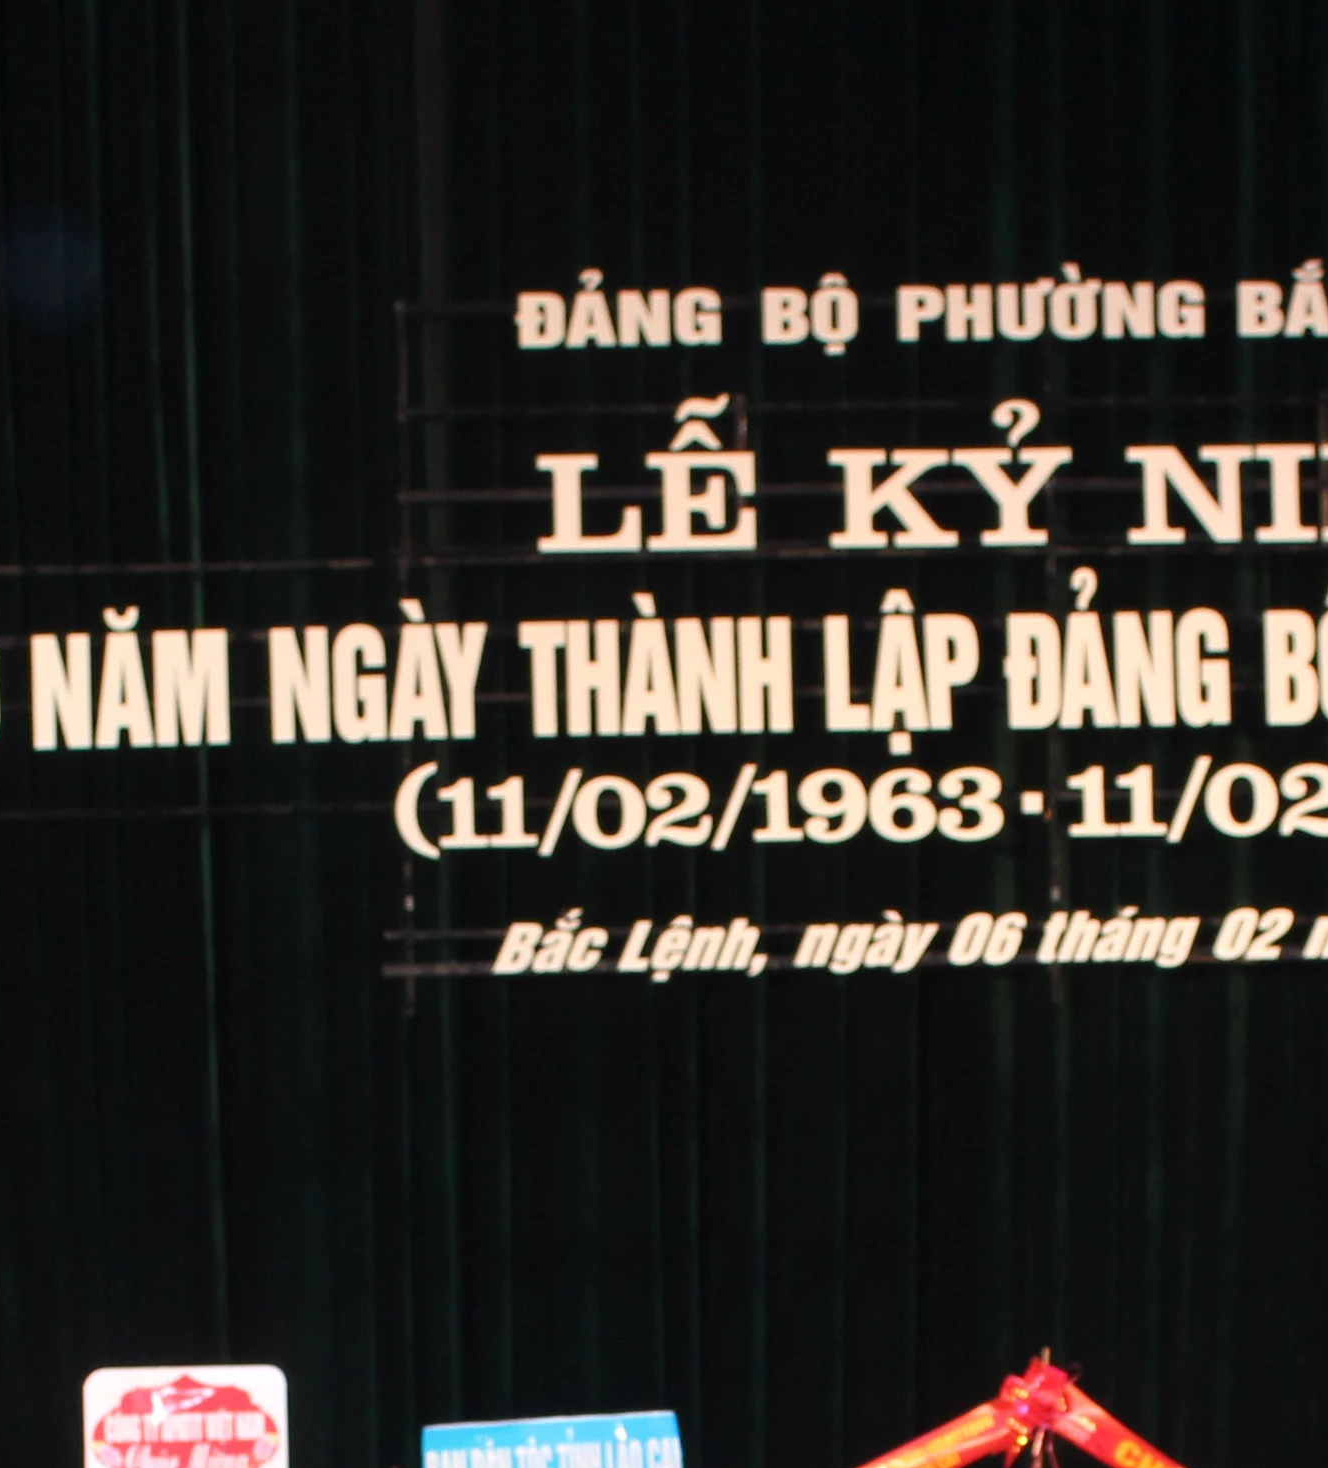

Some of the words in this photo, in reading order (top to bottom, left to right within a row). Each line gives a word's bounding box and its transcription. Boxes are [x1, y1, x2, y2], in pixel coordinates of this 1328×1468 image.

[515, 270, 722, 350] ĐẢNG
[762, 273, 858, 355] BỘ
[897, 263, 1205, 343] PHƯỜNG
[536, 394, 757, 553] LỄ
[828, 400, 1073, 549] KỶ
[30, 606, 231, 751] NĂM
[271, 599, 487, 744] NGÀY
[518, 592, 793, 738] THÀNH
[823, 589, 979, 756] LẬP
[1003, 567, 1231, 730] ĐẢNG
[491, 907, 609, 975] Bắc
[616, 914, 769, 983] Lệnh,
[793, 909, 940, 975] ngày
[947, 911, 1028, 966] 06
[1035, 905, 1201, 968] tháng
[1212, 906, 1295, 961] 02
